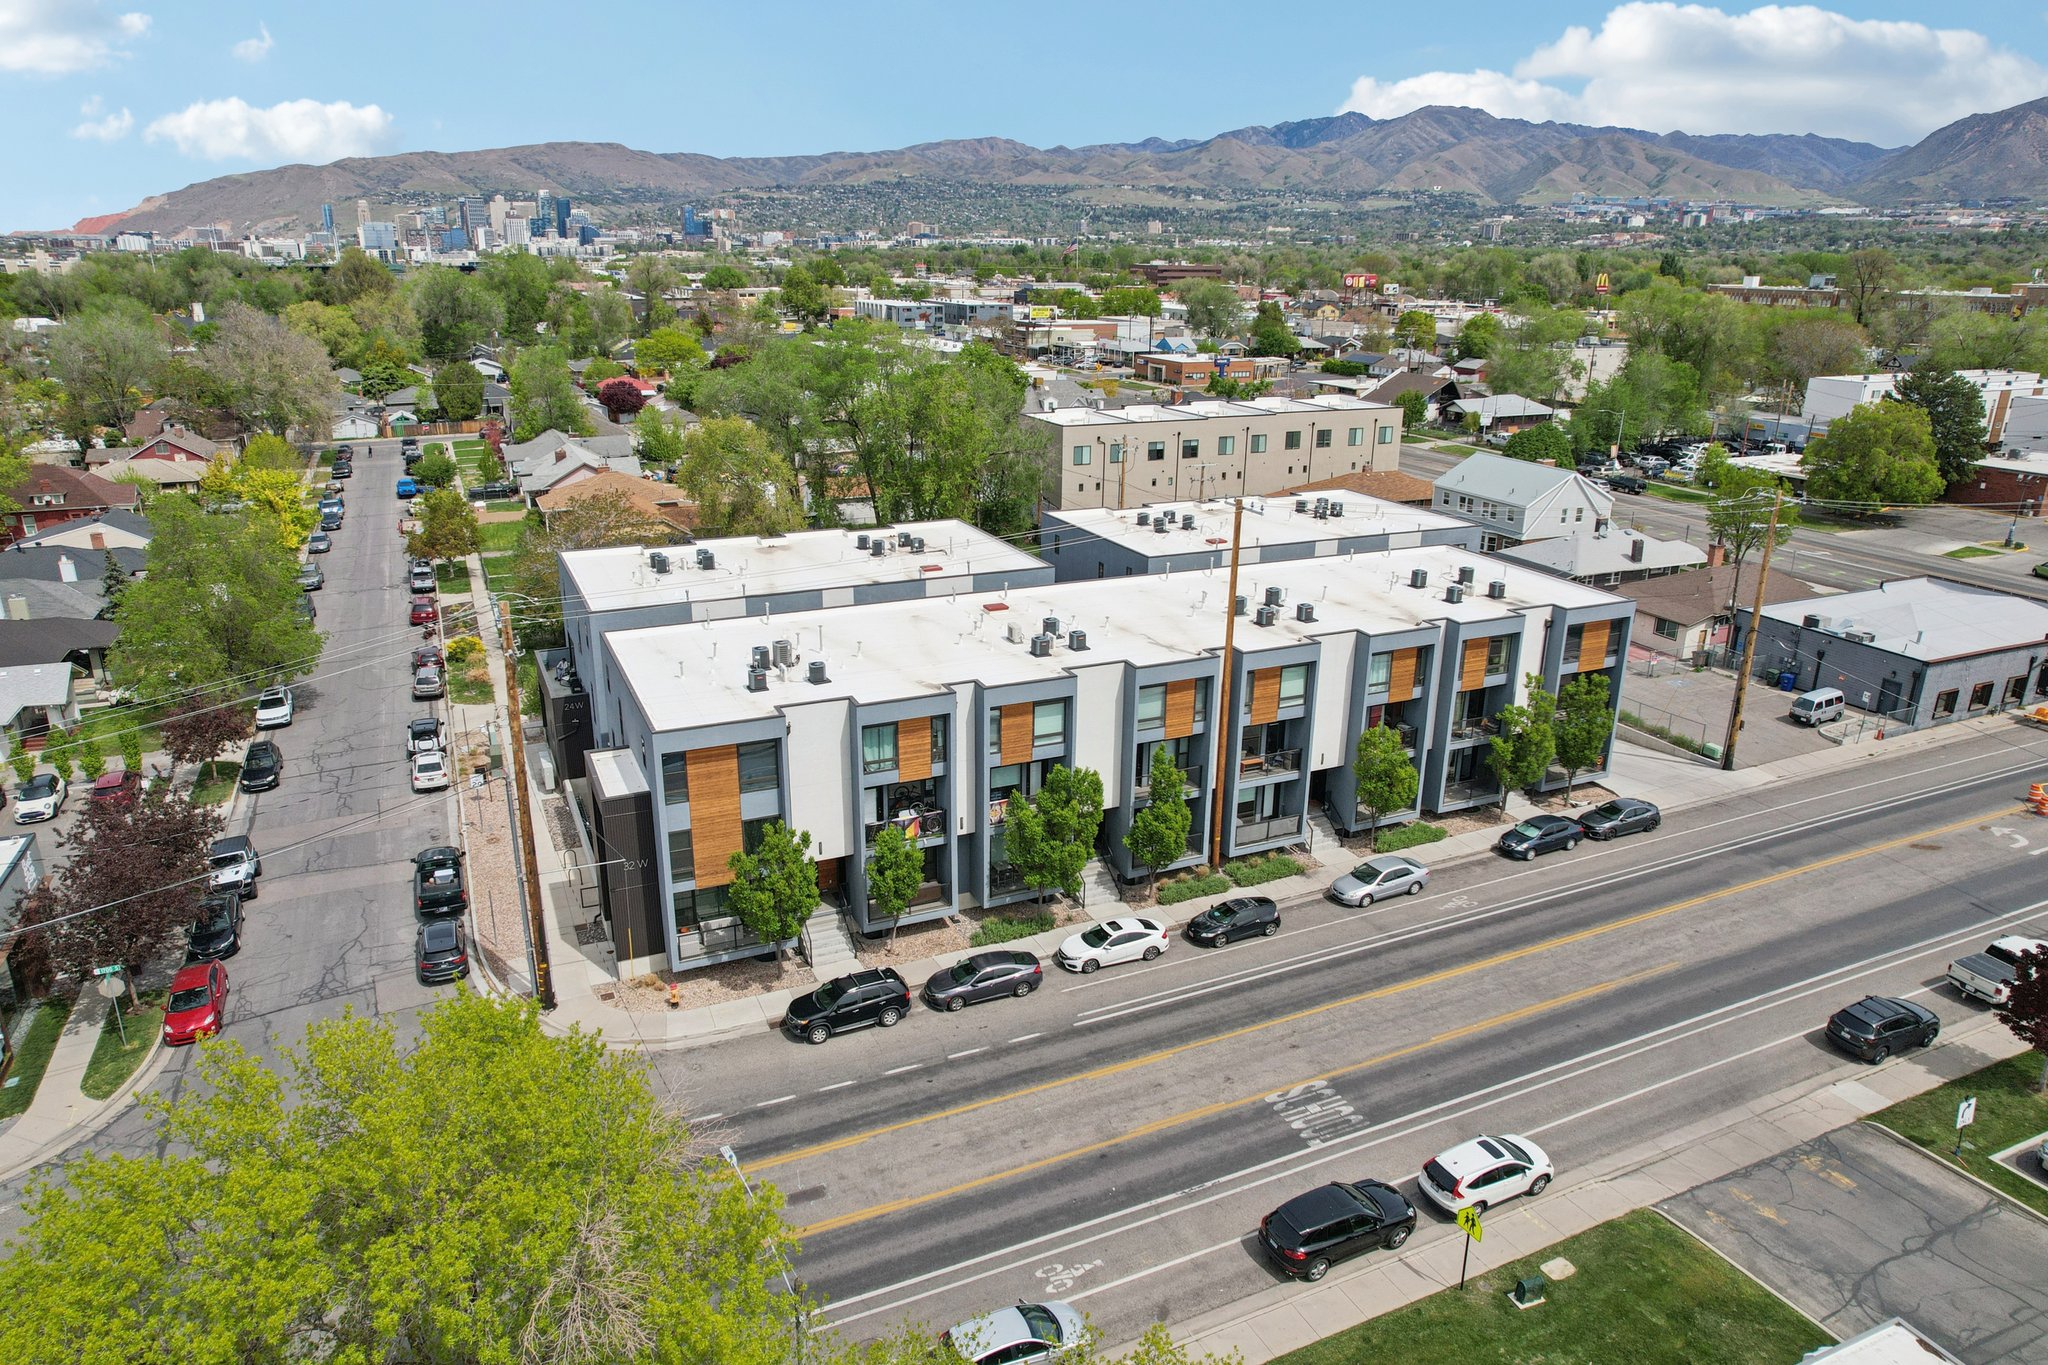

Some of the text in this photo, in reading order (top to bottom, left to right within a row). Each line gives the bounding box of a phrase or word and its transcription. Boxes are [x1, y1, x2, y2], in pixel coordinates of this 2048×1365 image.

[623, 858, 649, 871] 32 W
[1264, 1080, 1370, 1148] SCHOOL
